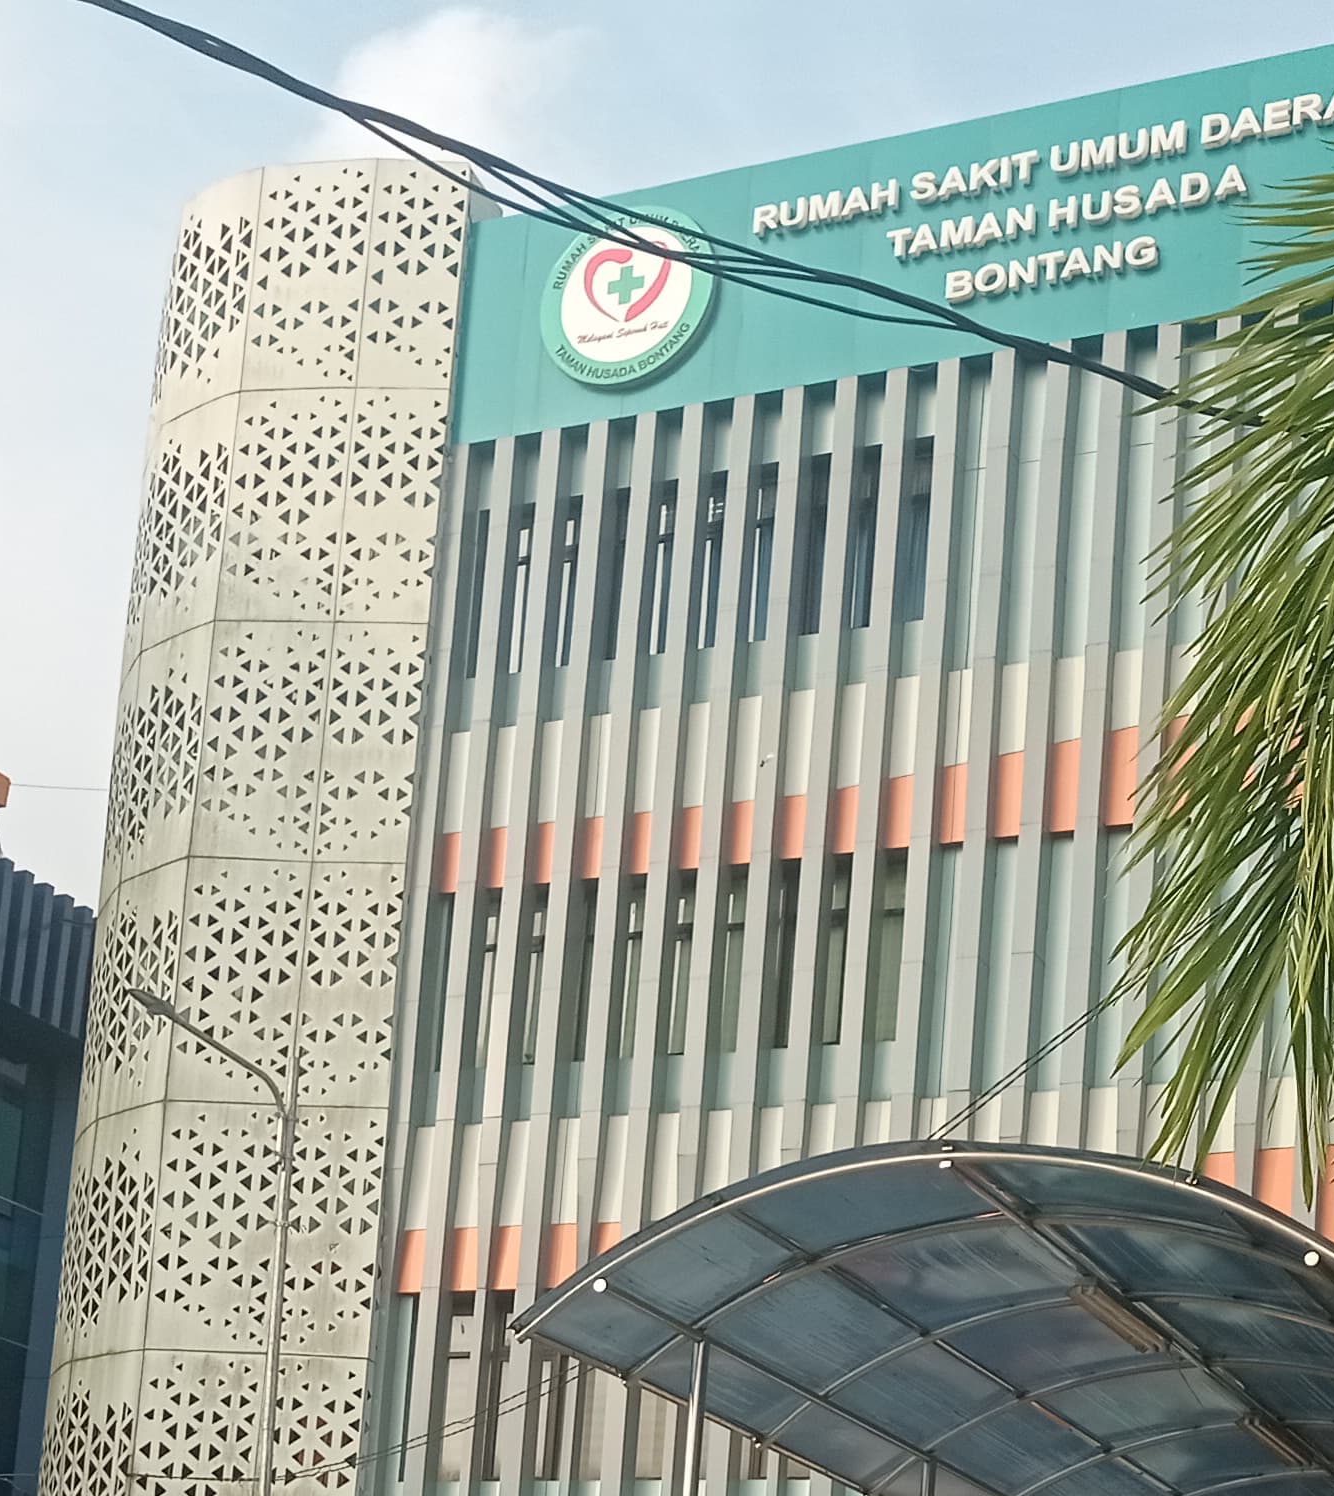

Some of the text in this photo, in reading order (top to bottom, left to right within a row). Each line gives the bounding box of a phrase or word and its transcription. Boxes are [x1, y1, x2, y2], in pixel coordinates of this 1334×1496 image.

[752, 178, 900, 235] RUMAH
[910, 150, 1039, 204] SAKIT
[1050, 120, 1187, 177] UMUM
[886, 164, 1247, 257] TAMAN HUSADA
[553, 243, 587, 290] RUMAH
[945, 236, 1158, 304] BONTANG
[555, 322, 690, 379] TAMAN HUSADA BONTANG
